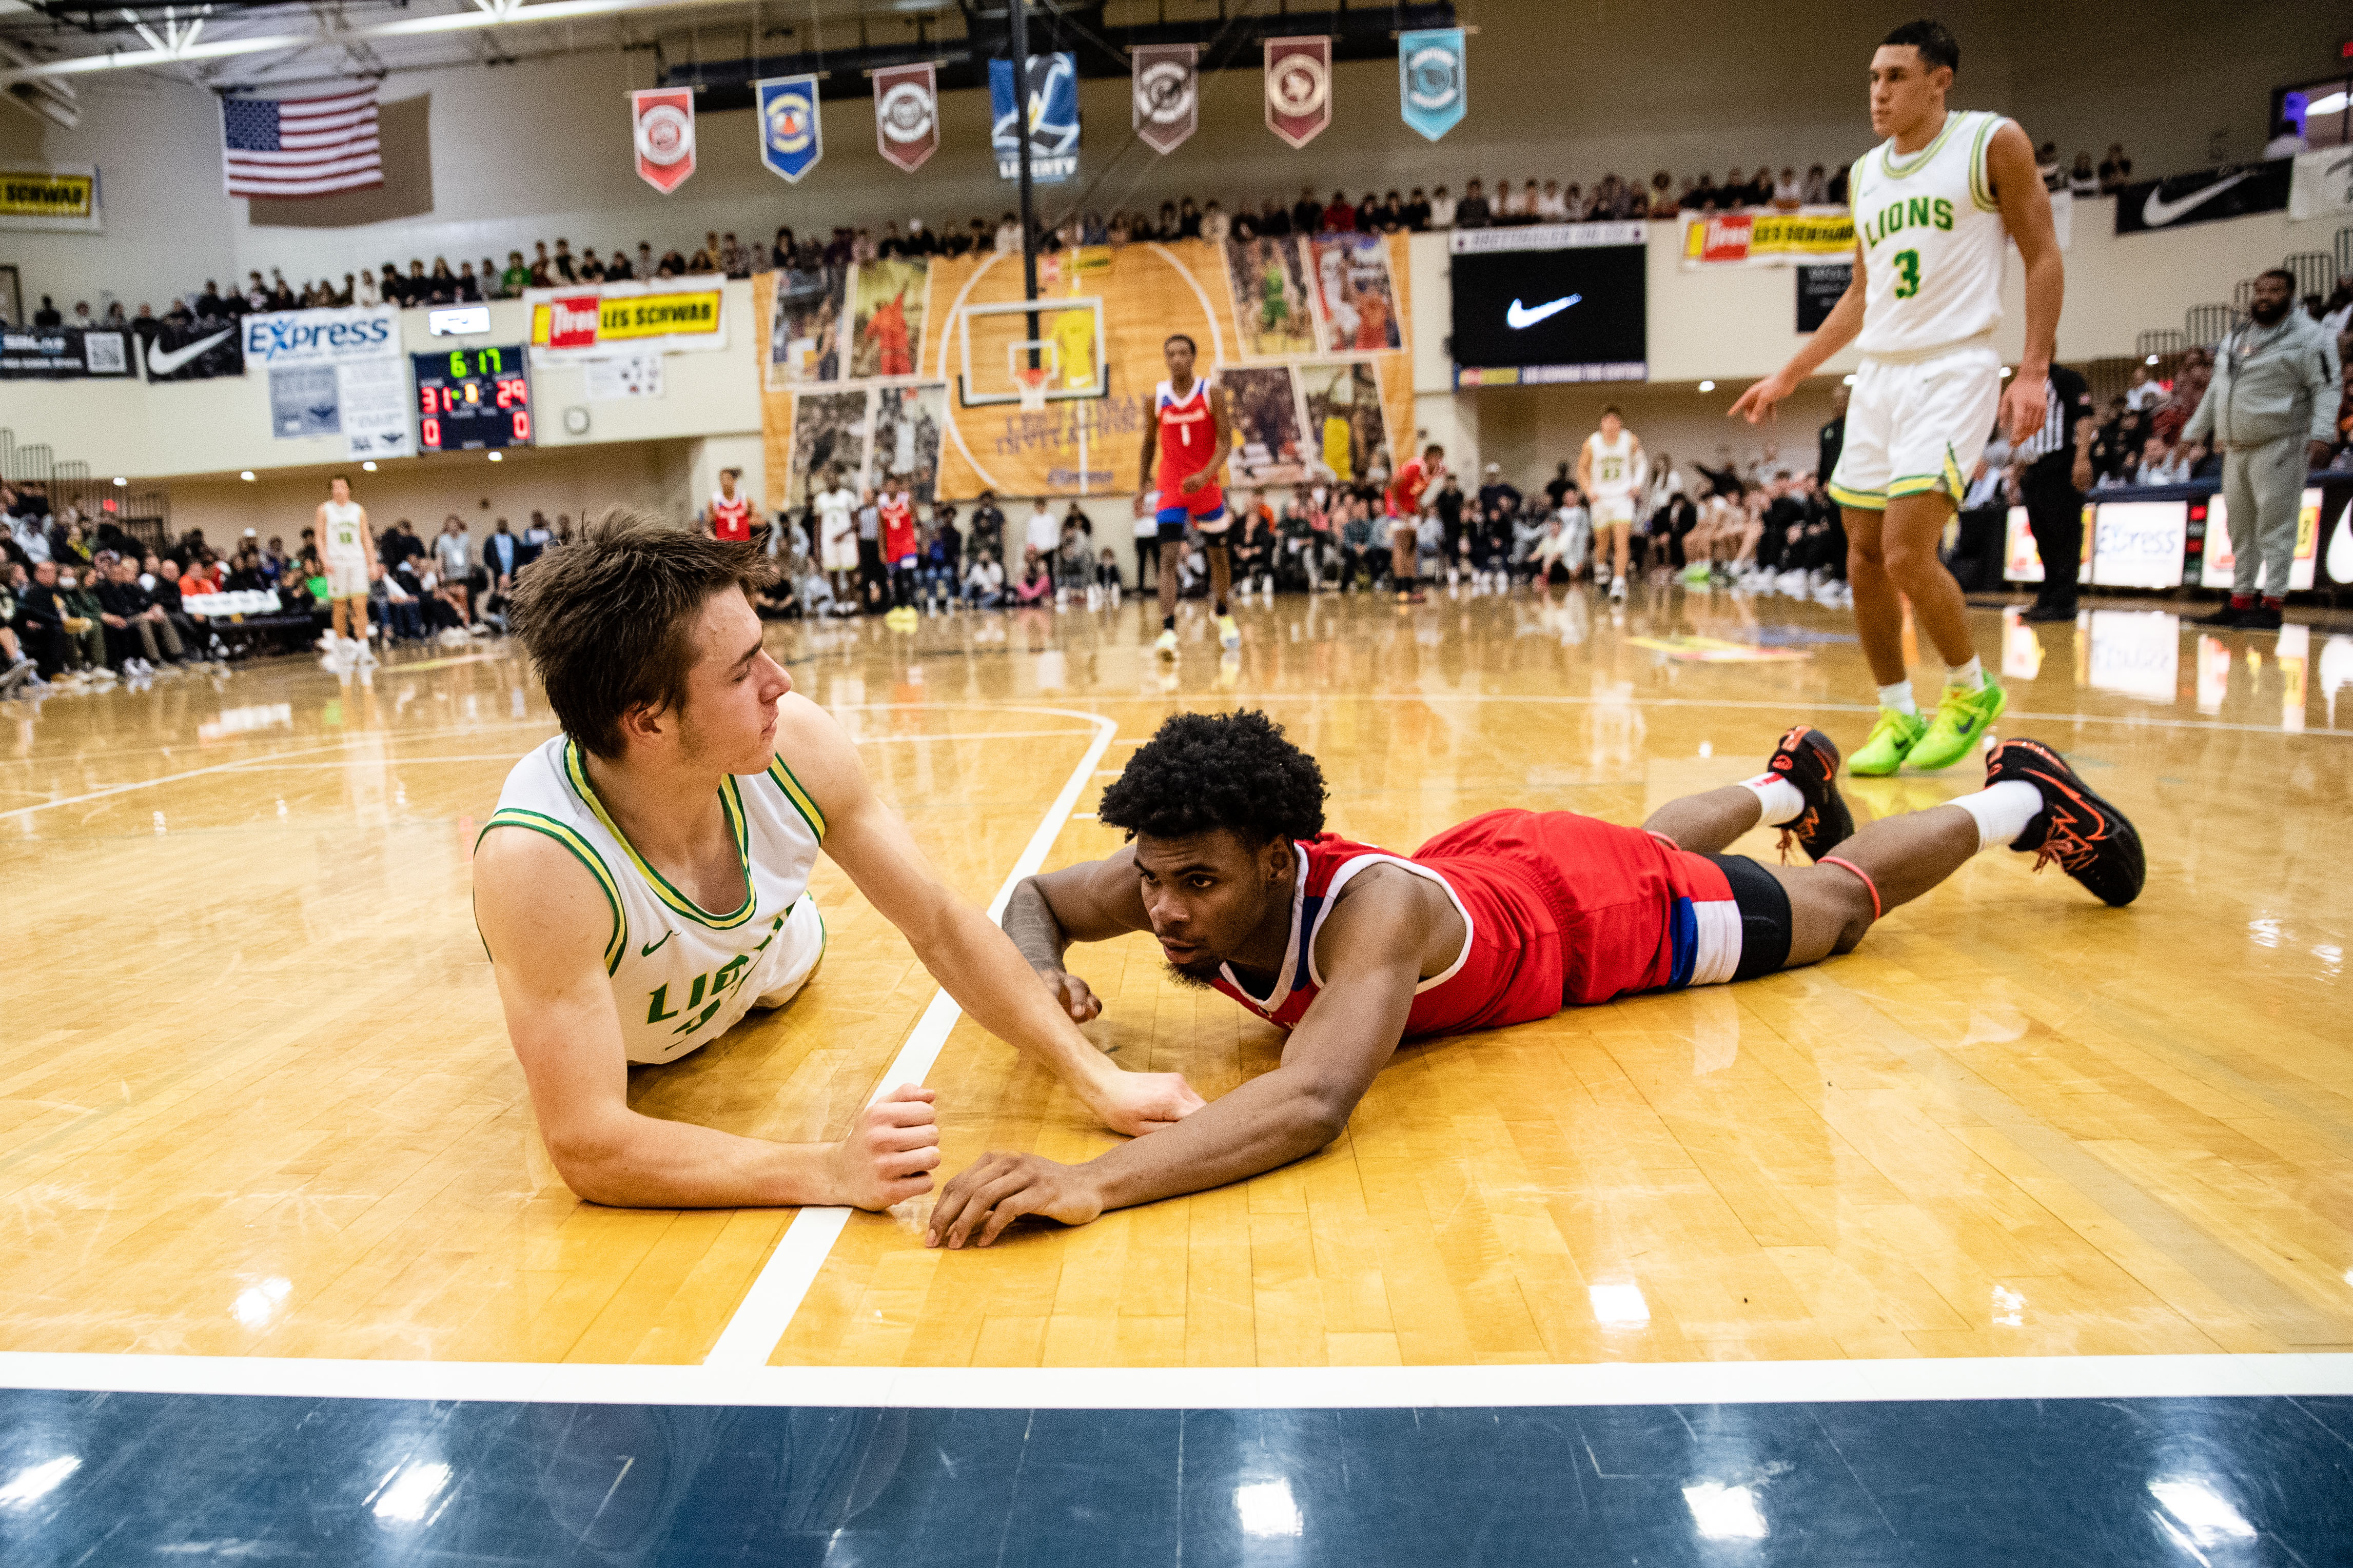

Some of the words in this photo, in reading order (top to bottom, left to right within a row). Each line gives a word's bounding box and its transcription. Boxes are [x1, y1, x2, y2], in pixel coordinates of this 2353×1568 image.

[1865, 196, 1954, 249] LIONS
[1892, 249, 1920, 299] 3
[602, 309, 630, 329] LES
[635, 303, 711, 327] SCHWAB
[421, 386, 453, 414] 31
[496, 379, 528, 409] 29
[423, 418, 442, 446] 0
[513, 411, 530, 440] 0
